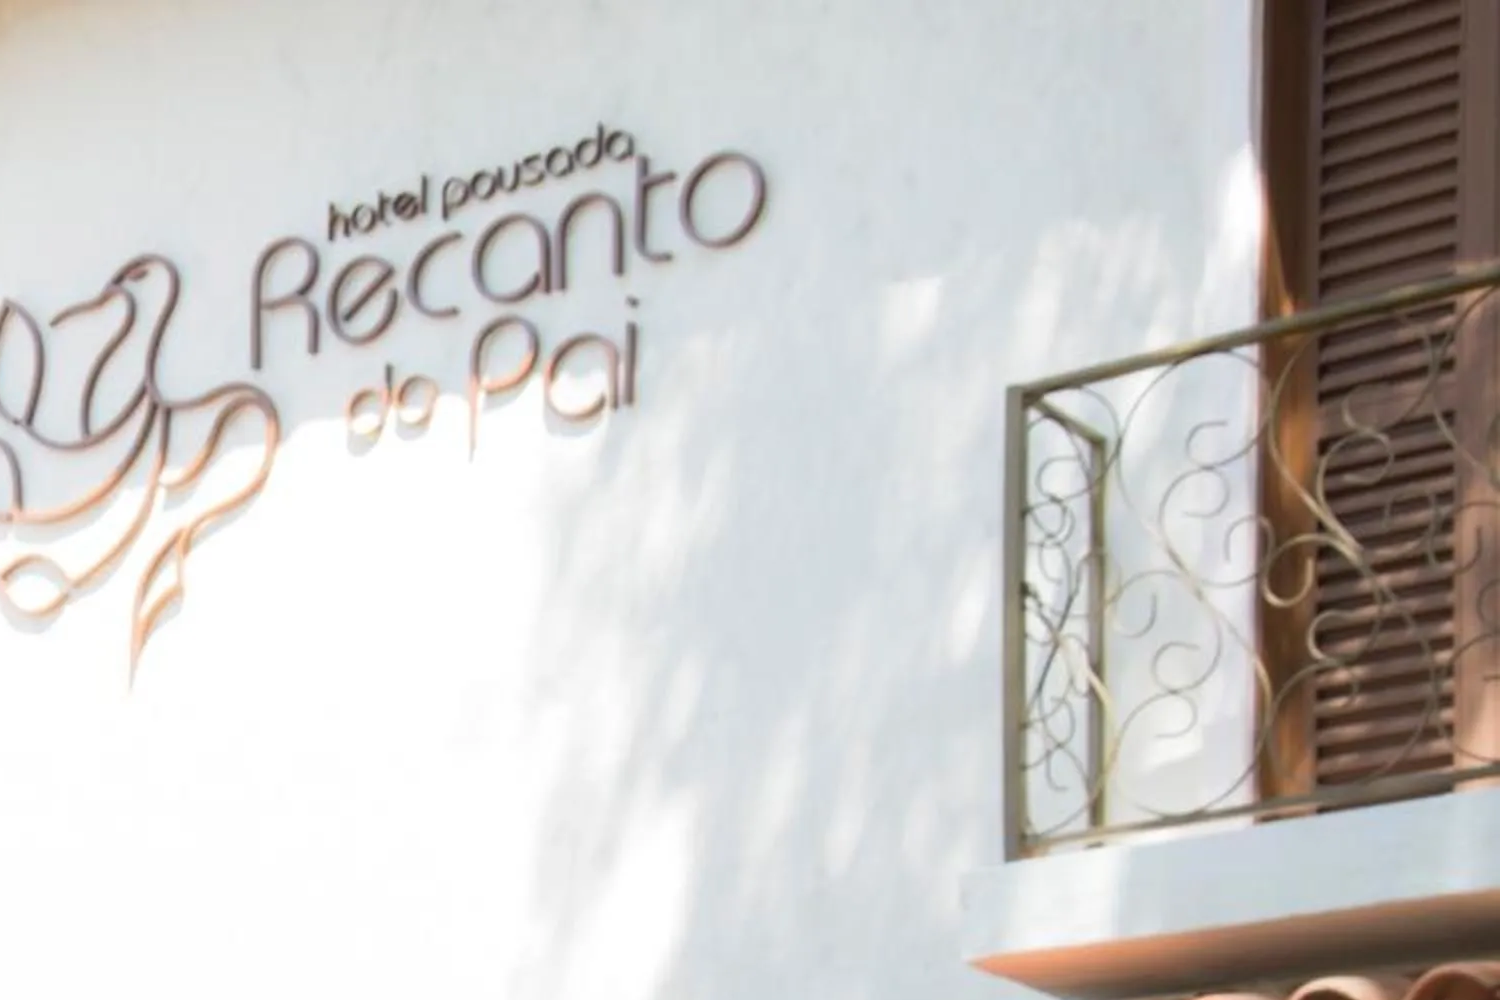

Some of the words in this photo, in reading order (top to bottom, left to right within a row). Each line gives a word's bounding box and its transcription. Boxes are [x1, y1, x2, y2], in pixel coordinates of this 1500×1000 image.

[250, 151, 768, 370] Recanto
[327, 175, 428, 241] hotel
[442, 122, 635, 220] pousada
[348, 364, 438, 437] do
[469, 297, 640, 461] Pai
